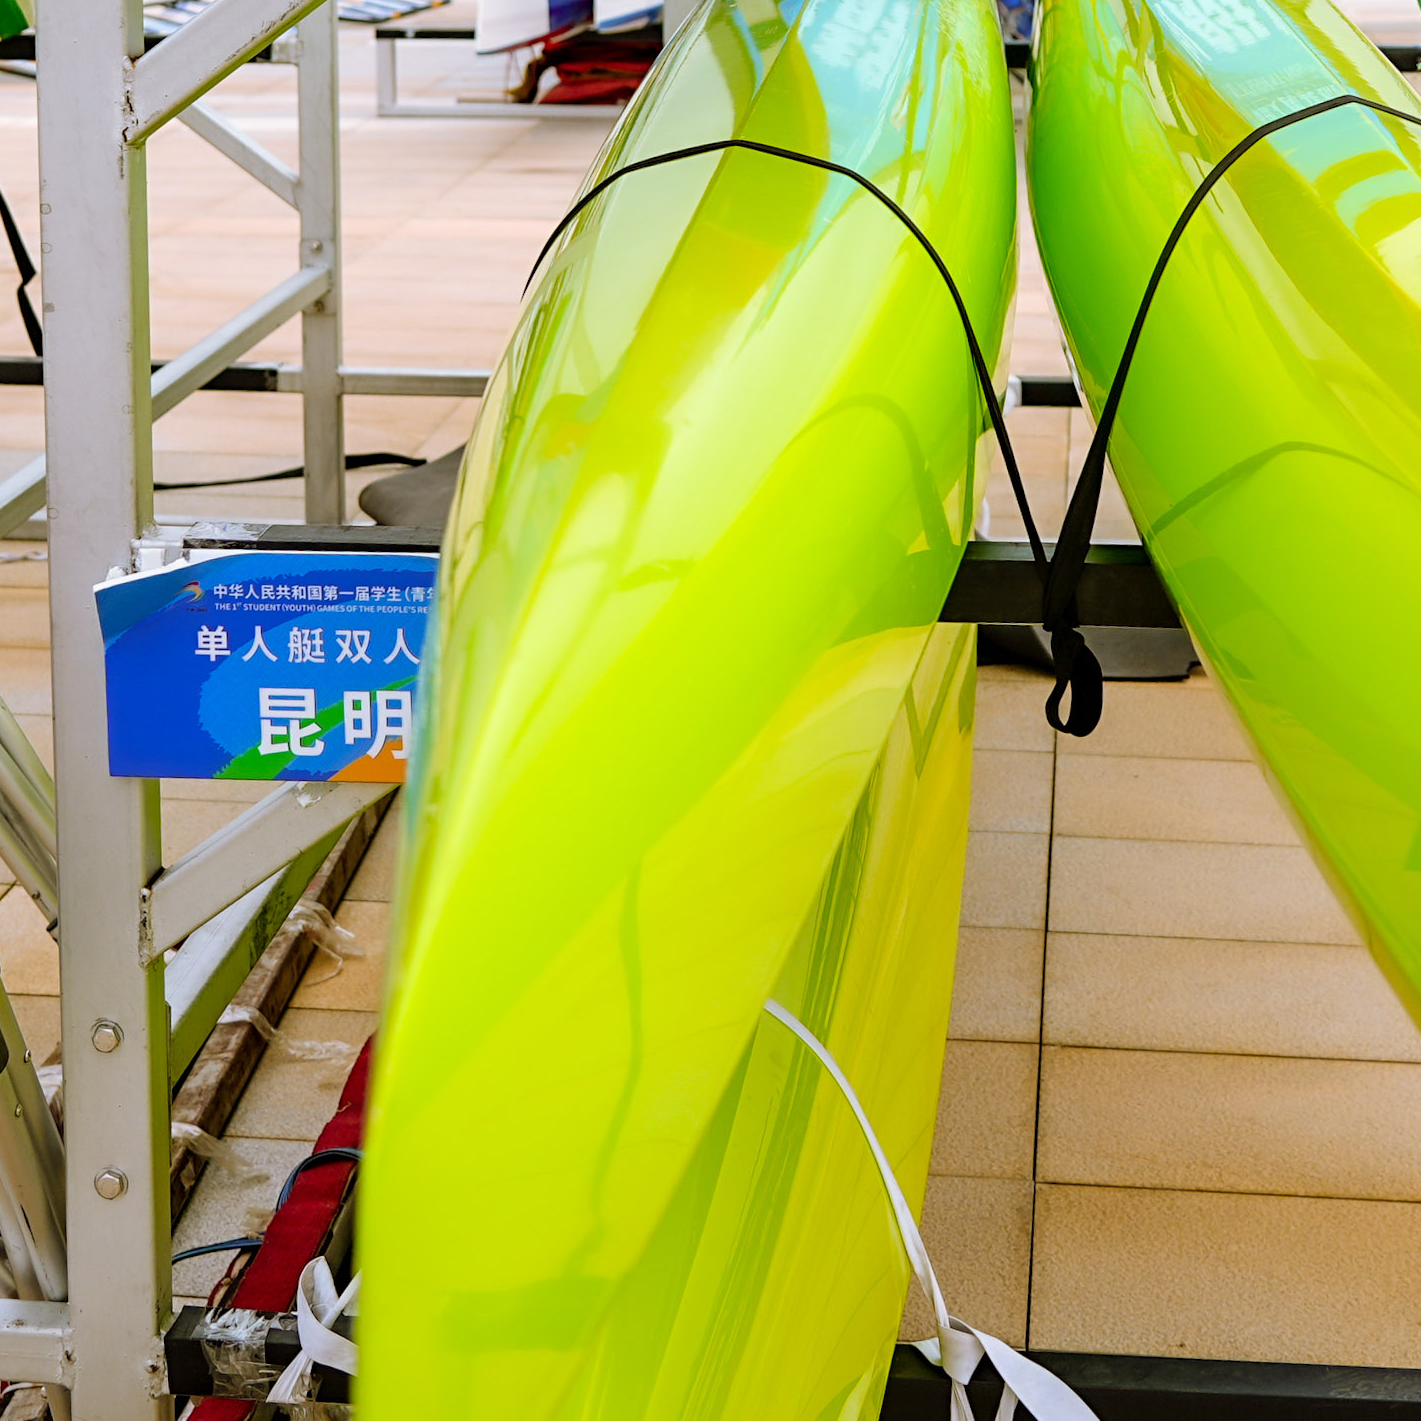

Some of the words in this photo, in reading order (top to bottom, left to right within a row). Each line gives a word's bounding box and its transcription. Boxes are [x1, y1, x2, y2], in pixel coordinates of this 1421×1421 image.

[214, 602, 230, 611] THE
[244, 603, 281, 612] STUDENT
[282, 603, 316, 613] (YOUTH)
[317, 604, 346, 612] GAMES
[359, 605, 375, 613] THE
[376, 606, 416, 614] PEOPLE'S
[195, 625, 420, 664] 单人艇双人
[258, 687, 413, 760] 昆明
